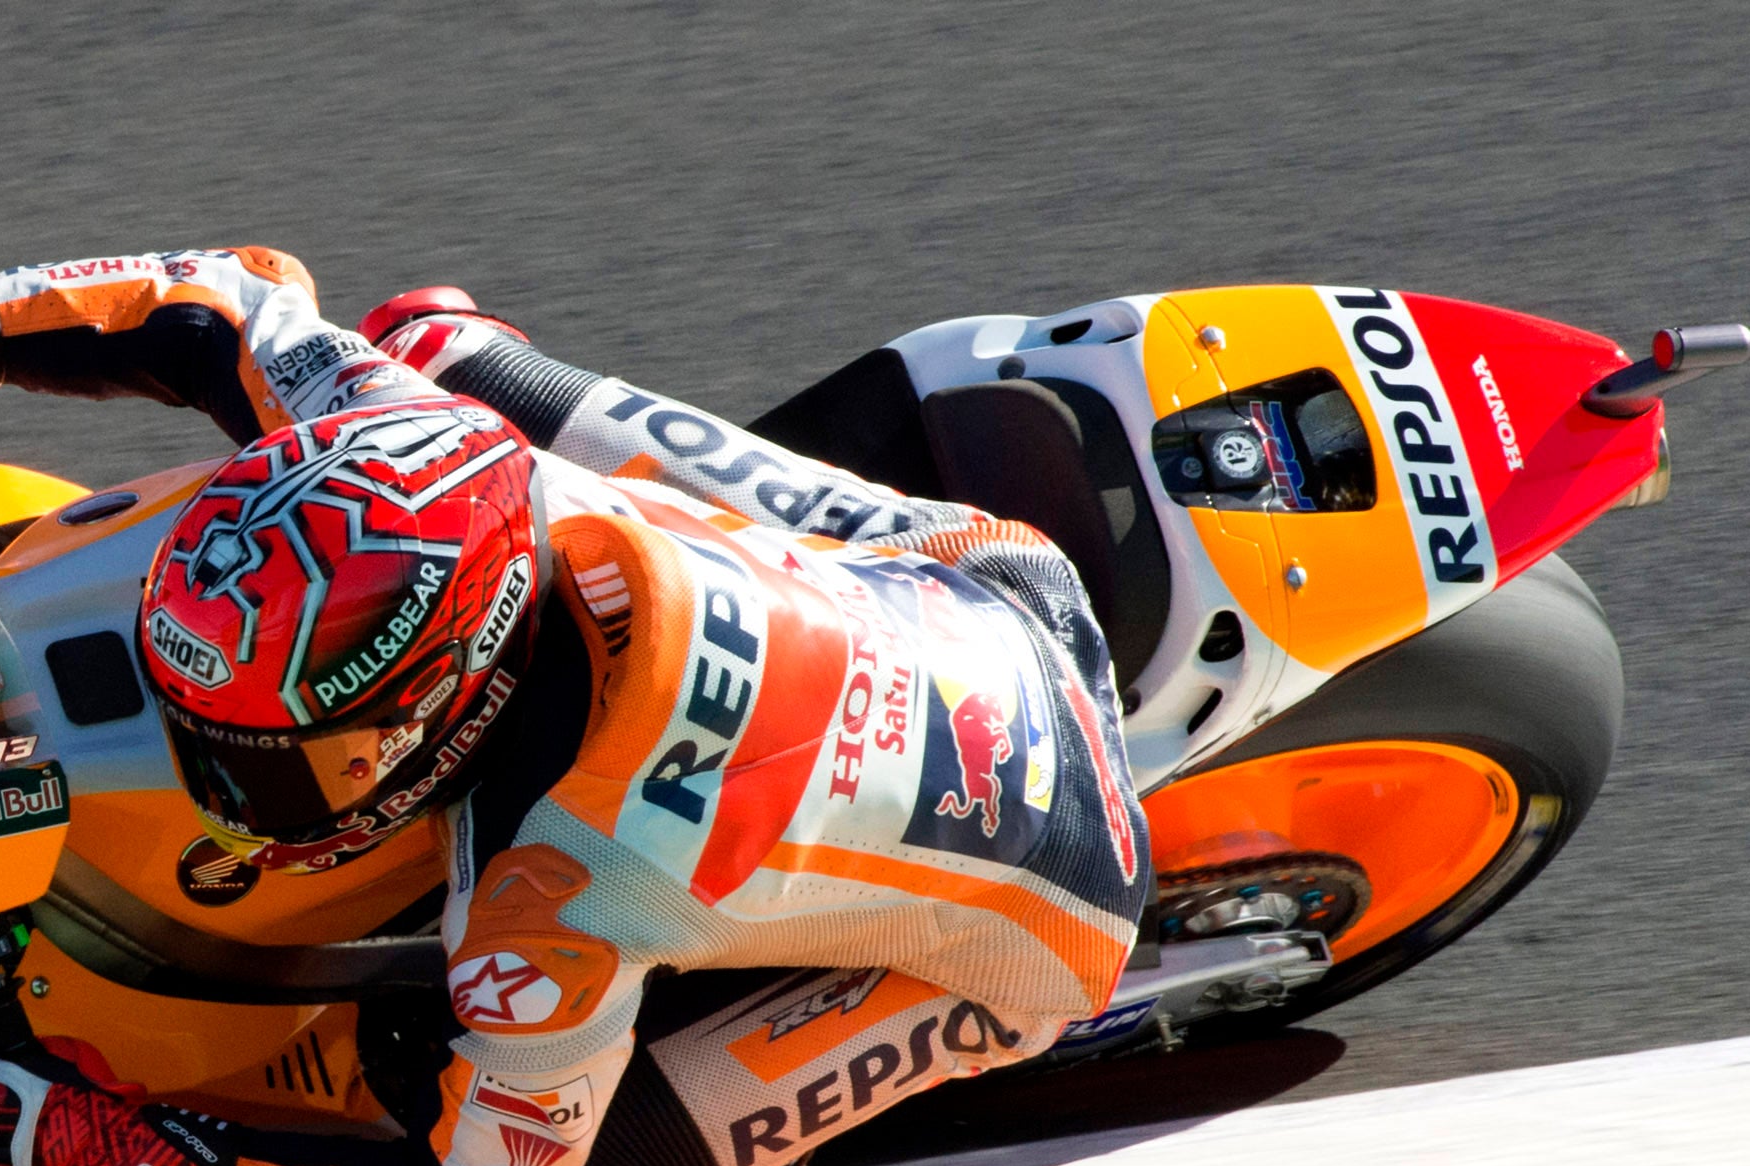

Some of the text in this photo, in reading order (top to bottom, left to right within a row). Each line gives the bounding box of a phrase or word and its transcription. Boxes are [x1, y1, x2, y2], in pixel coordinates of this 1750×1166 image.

[1335, 288, 1485, 584] REPSOL
[1471, 354, 1525, 472] HONDA
[154, 617, 218, 682] SHOEI
[315, 561, 446, 707] PULL&BEAR
[477, 568, 527, 660] SHOEI
[377, 668, 518, 820] Red Bull
[419, 681, 453, 715] SHOEI
[875, 666, 911, 756] Satu
[0, 777, 64, 820] Bull
